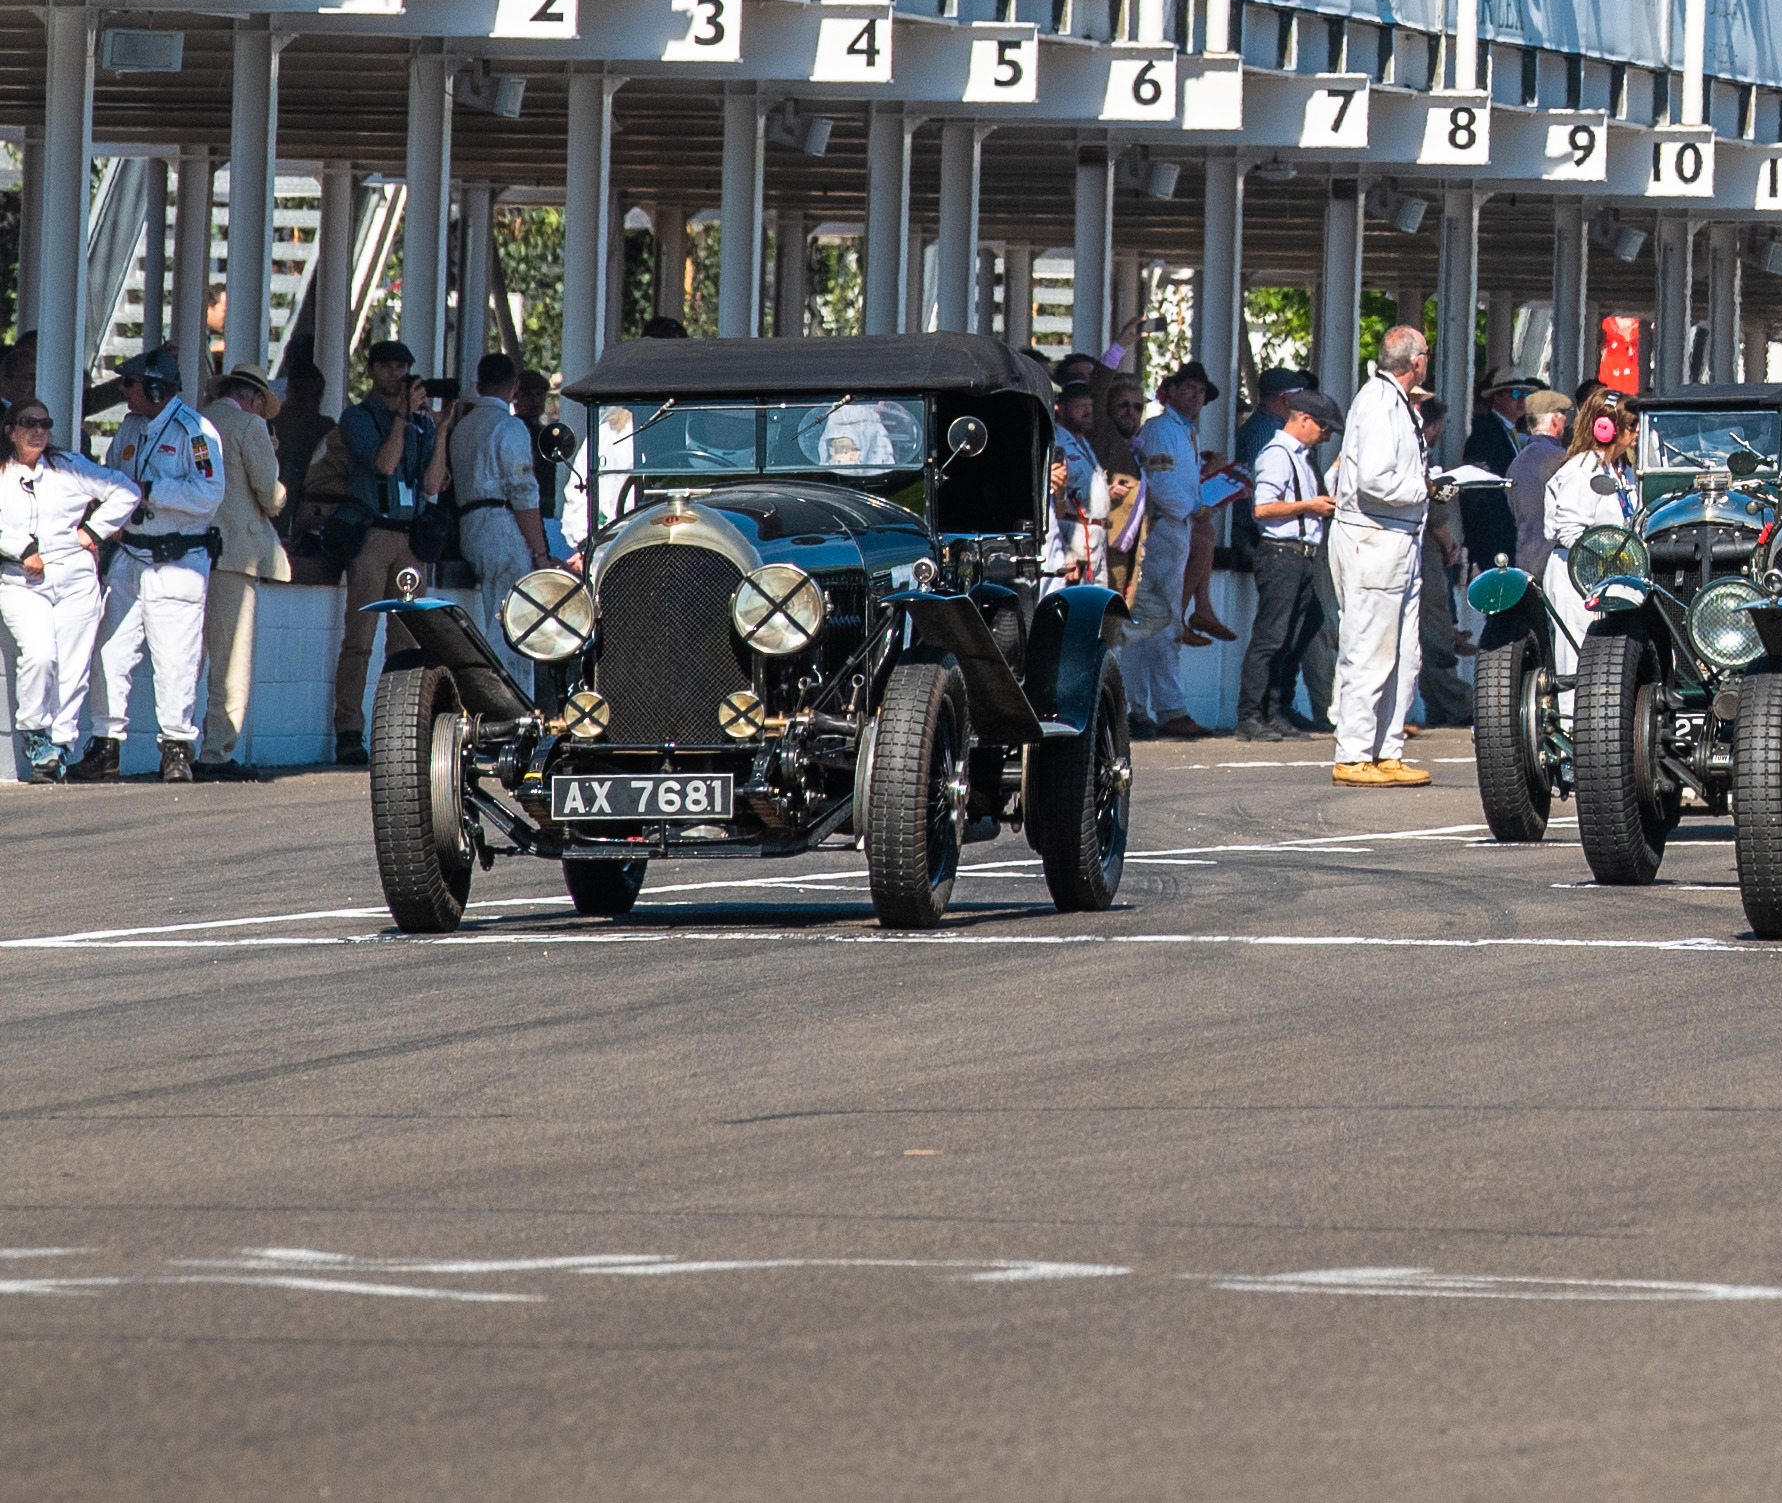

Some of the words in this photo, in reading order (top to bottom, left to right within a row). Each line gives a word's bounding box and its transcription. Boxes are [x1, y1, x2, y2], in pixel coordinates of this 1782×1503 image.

[847, 19, 880, 67] 4
[994, 40, 1022, 86] 5
[1133, 60, 1162, 105] 6
[1326, 89, 1356, 132] 7
[1448, 107, 1476, 150] 8
[1569, 125, 1596, 167] 9
[1652, 142, 1702, 183] 10
[563, 781, 613, 814] AX
[630, 780, 722, 813] 7681
